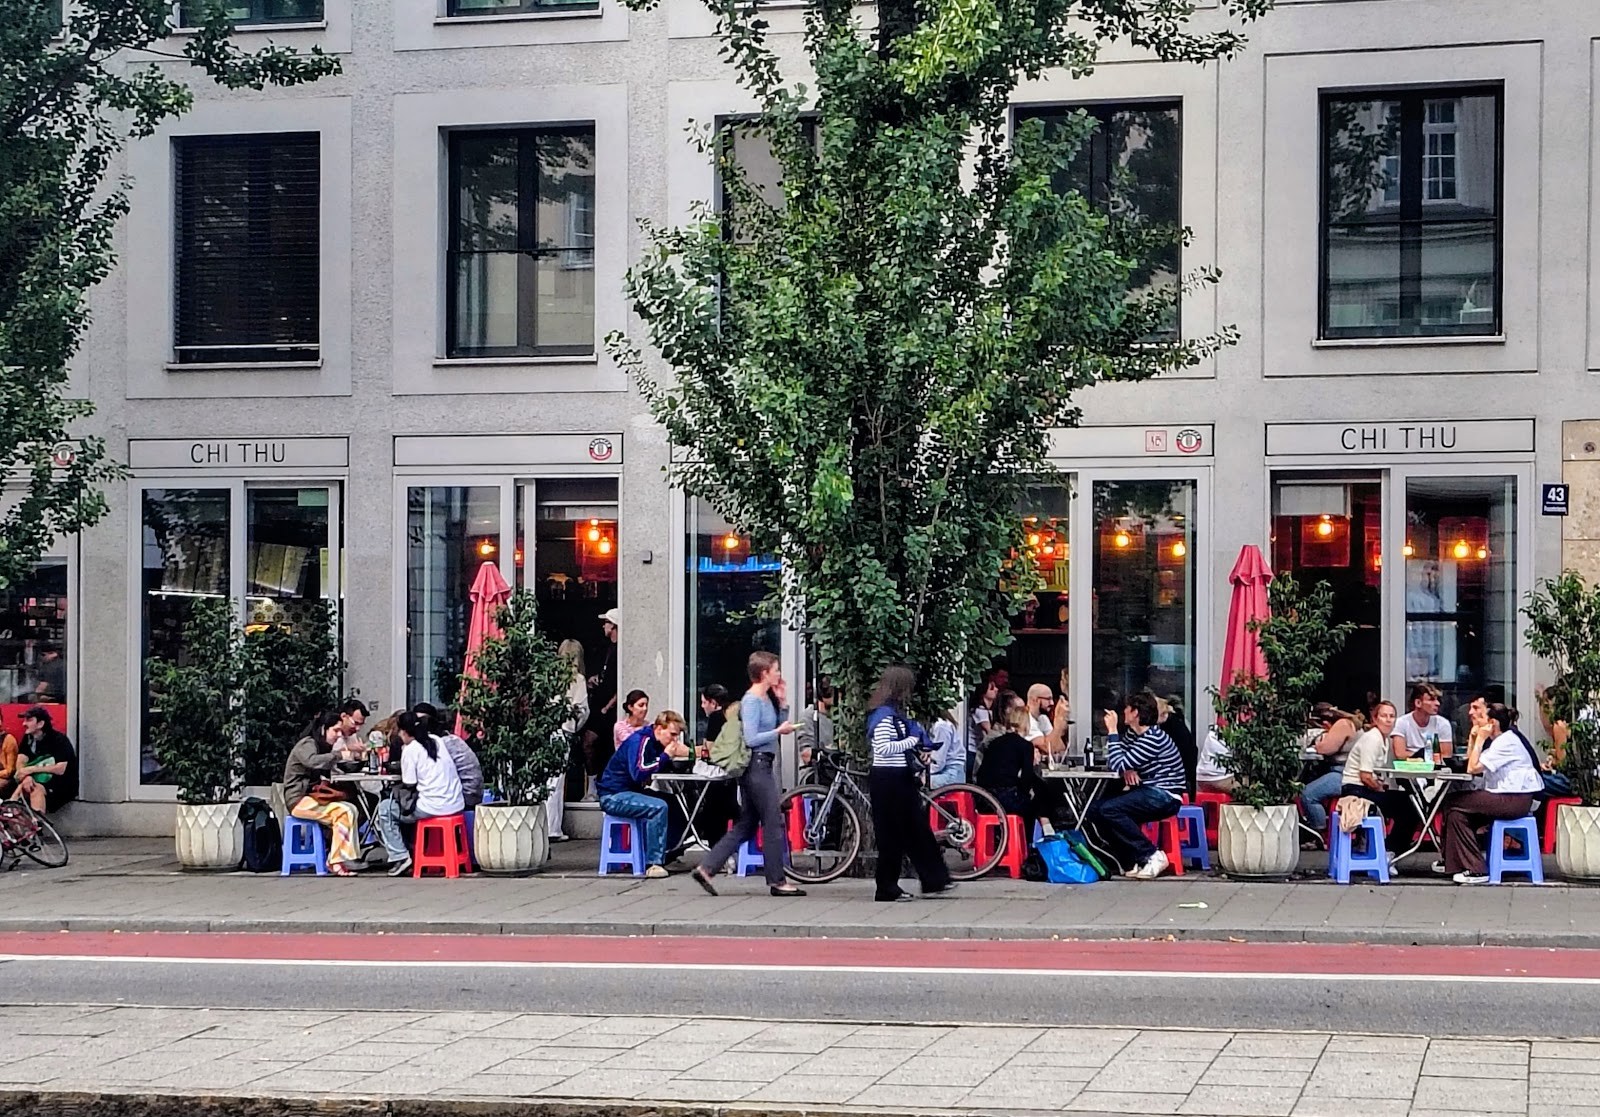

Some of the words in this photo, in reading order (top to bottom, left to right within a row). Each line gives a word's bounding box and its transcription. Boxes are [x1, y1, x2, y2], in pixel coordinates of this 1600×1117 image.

[1341, 428, 1386, 451] CHI
[1398, 427, 1456, 450] THU
[190, 443, 228, 464] CHI
[237, 443, 285, 463] THU
[1547, 487, 1565, 502] 43
